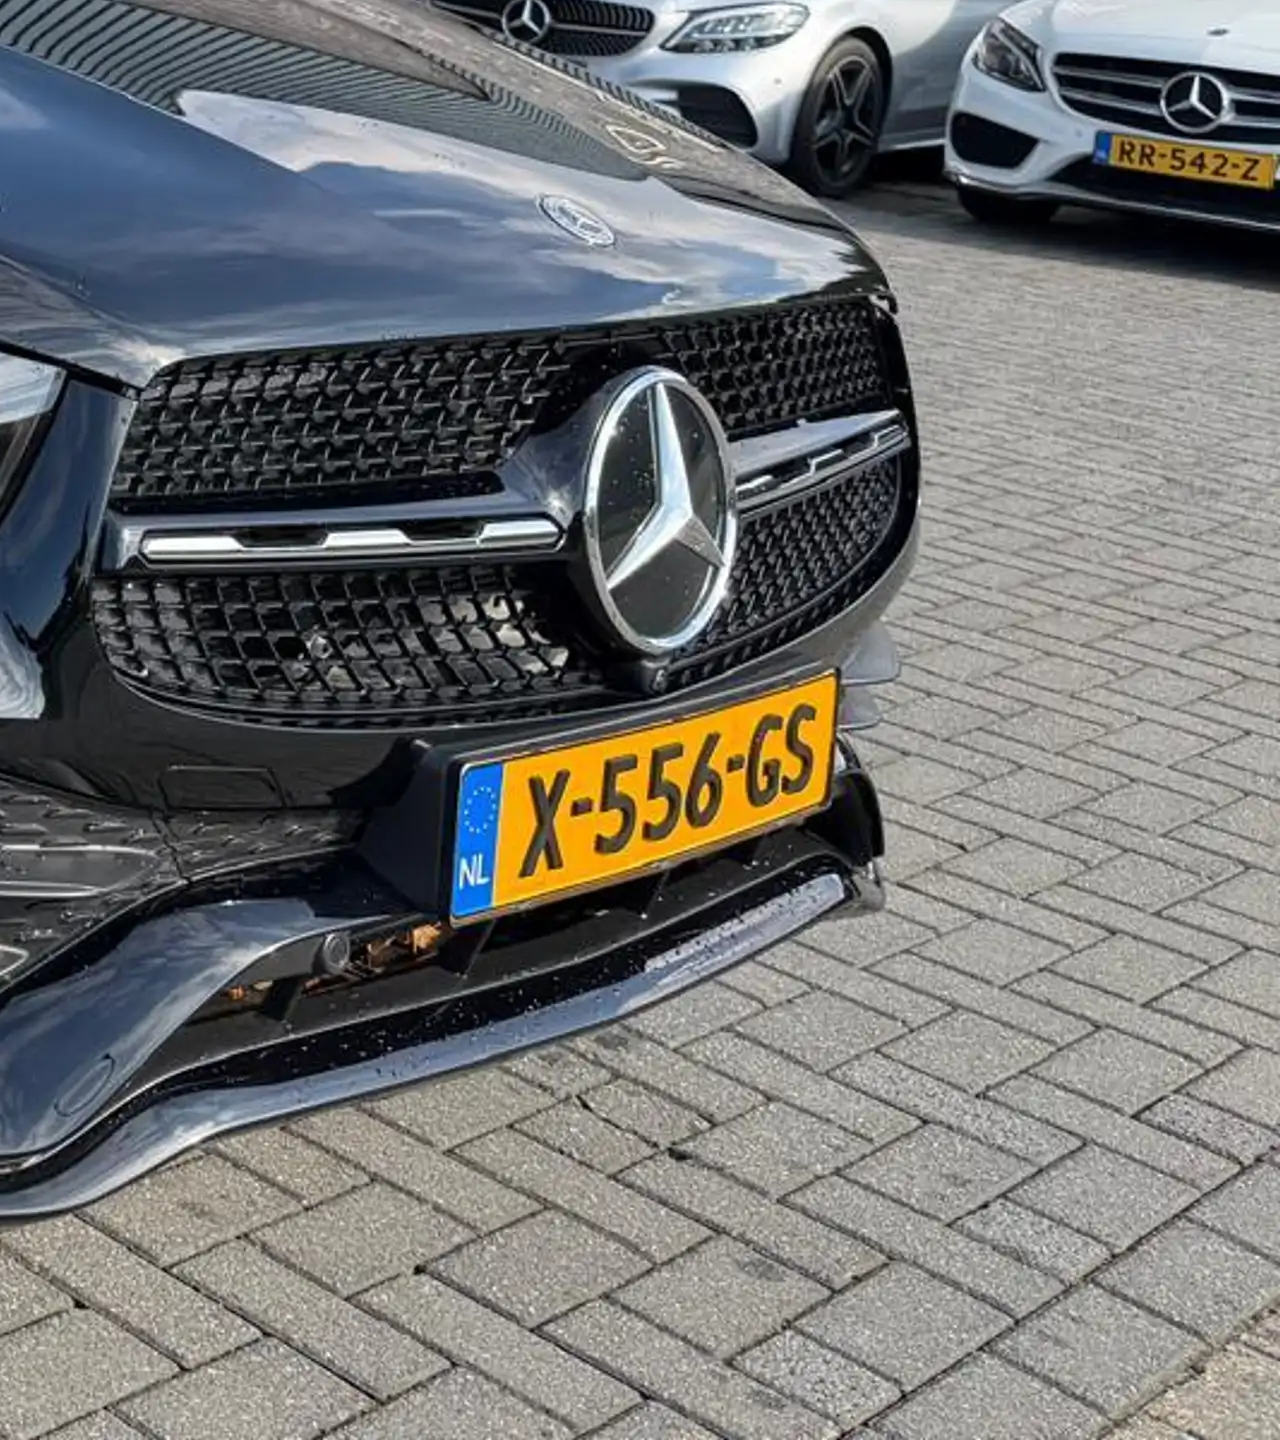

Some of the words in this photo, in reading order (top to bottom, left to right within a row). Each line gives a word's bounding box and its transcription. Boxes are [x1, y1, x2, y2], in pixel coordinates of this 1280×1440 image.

[1118, 138, 1260, 181] RR-542-Z
[519, 704, 818, 878] X-556-GS
[459, 858, 490, 890] NL
